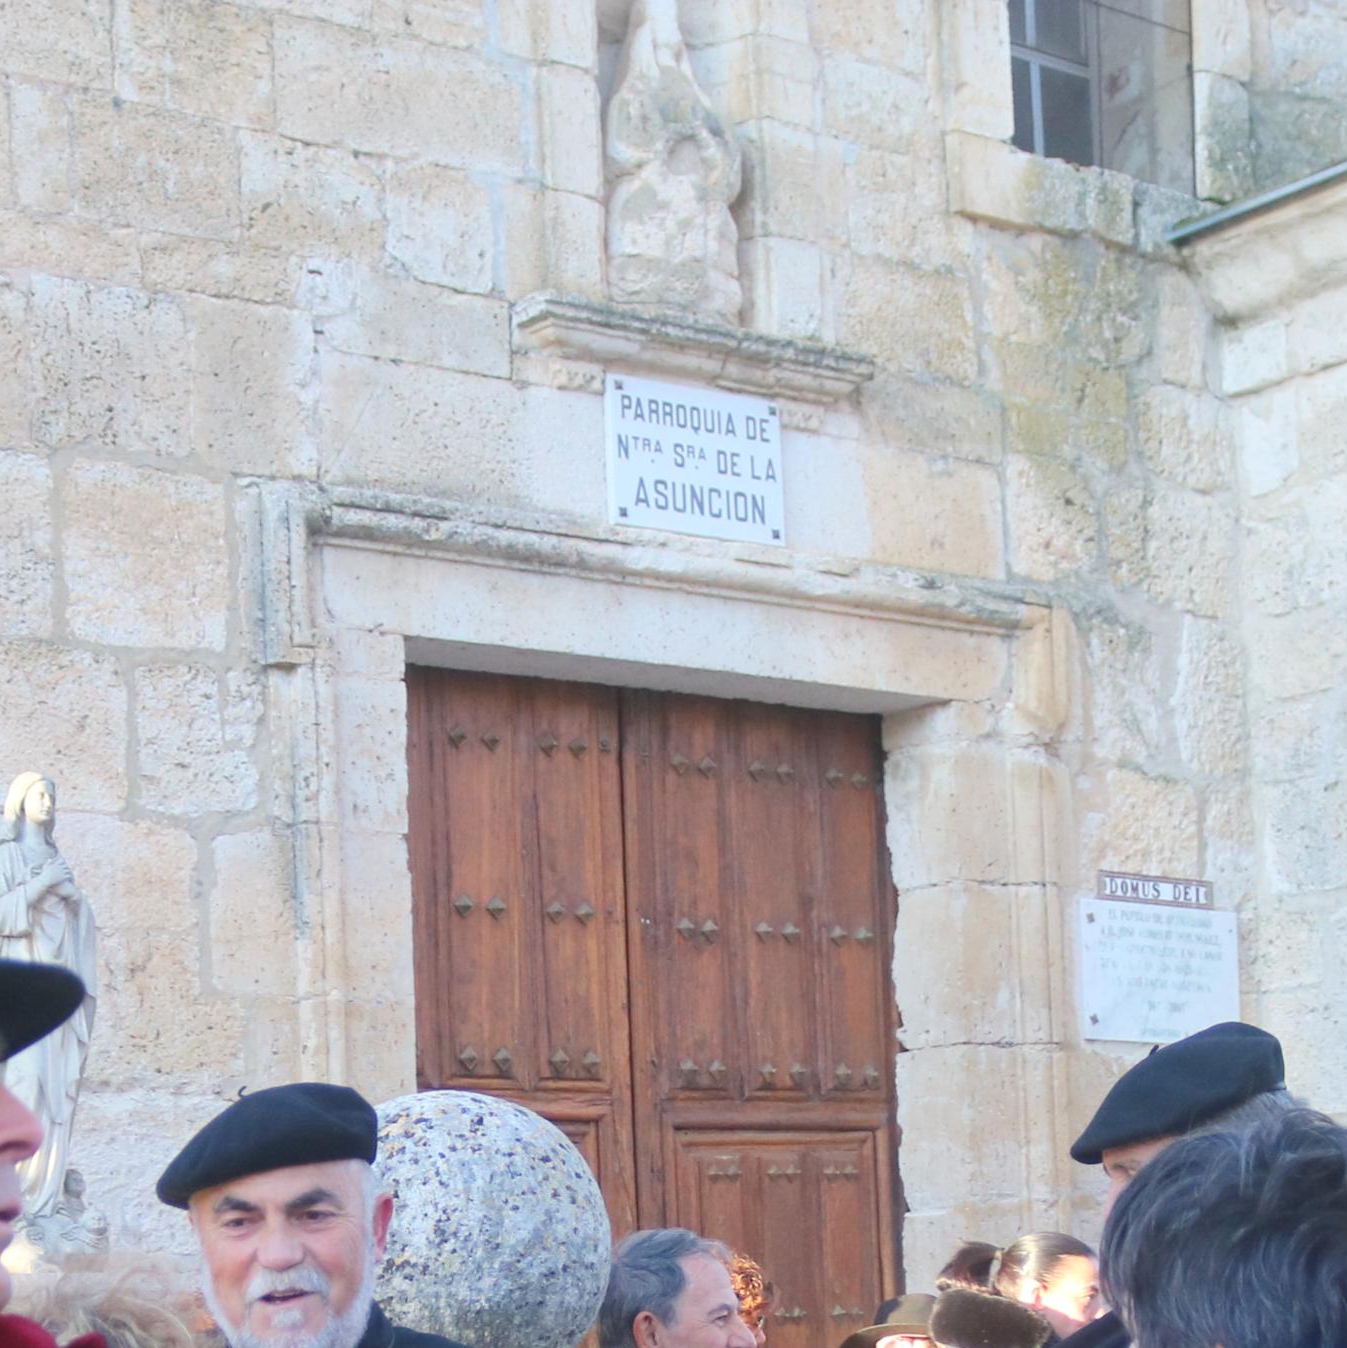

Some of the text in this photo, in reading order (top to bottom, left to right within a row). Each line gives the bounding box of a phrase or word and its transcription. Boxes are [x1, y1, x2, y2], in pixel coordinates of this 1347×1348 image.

[620, 393, 771, 443] PARROQUIA DE
[716, 449, 741, 477] DE
[750, 455, 777, 482] LA
[634, 475, 766, 525] ASUNCION
[1109, 878, 1200, 903] DOMUS DEI
